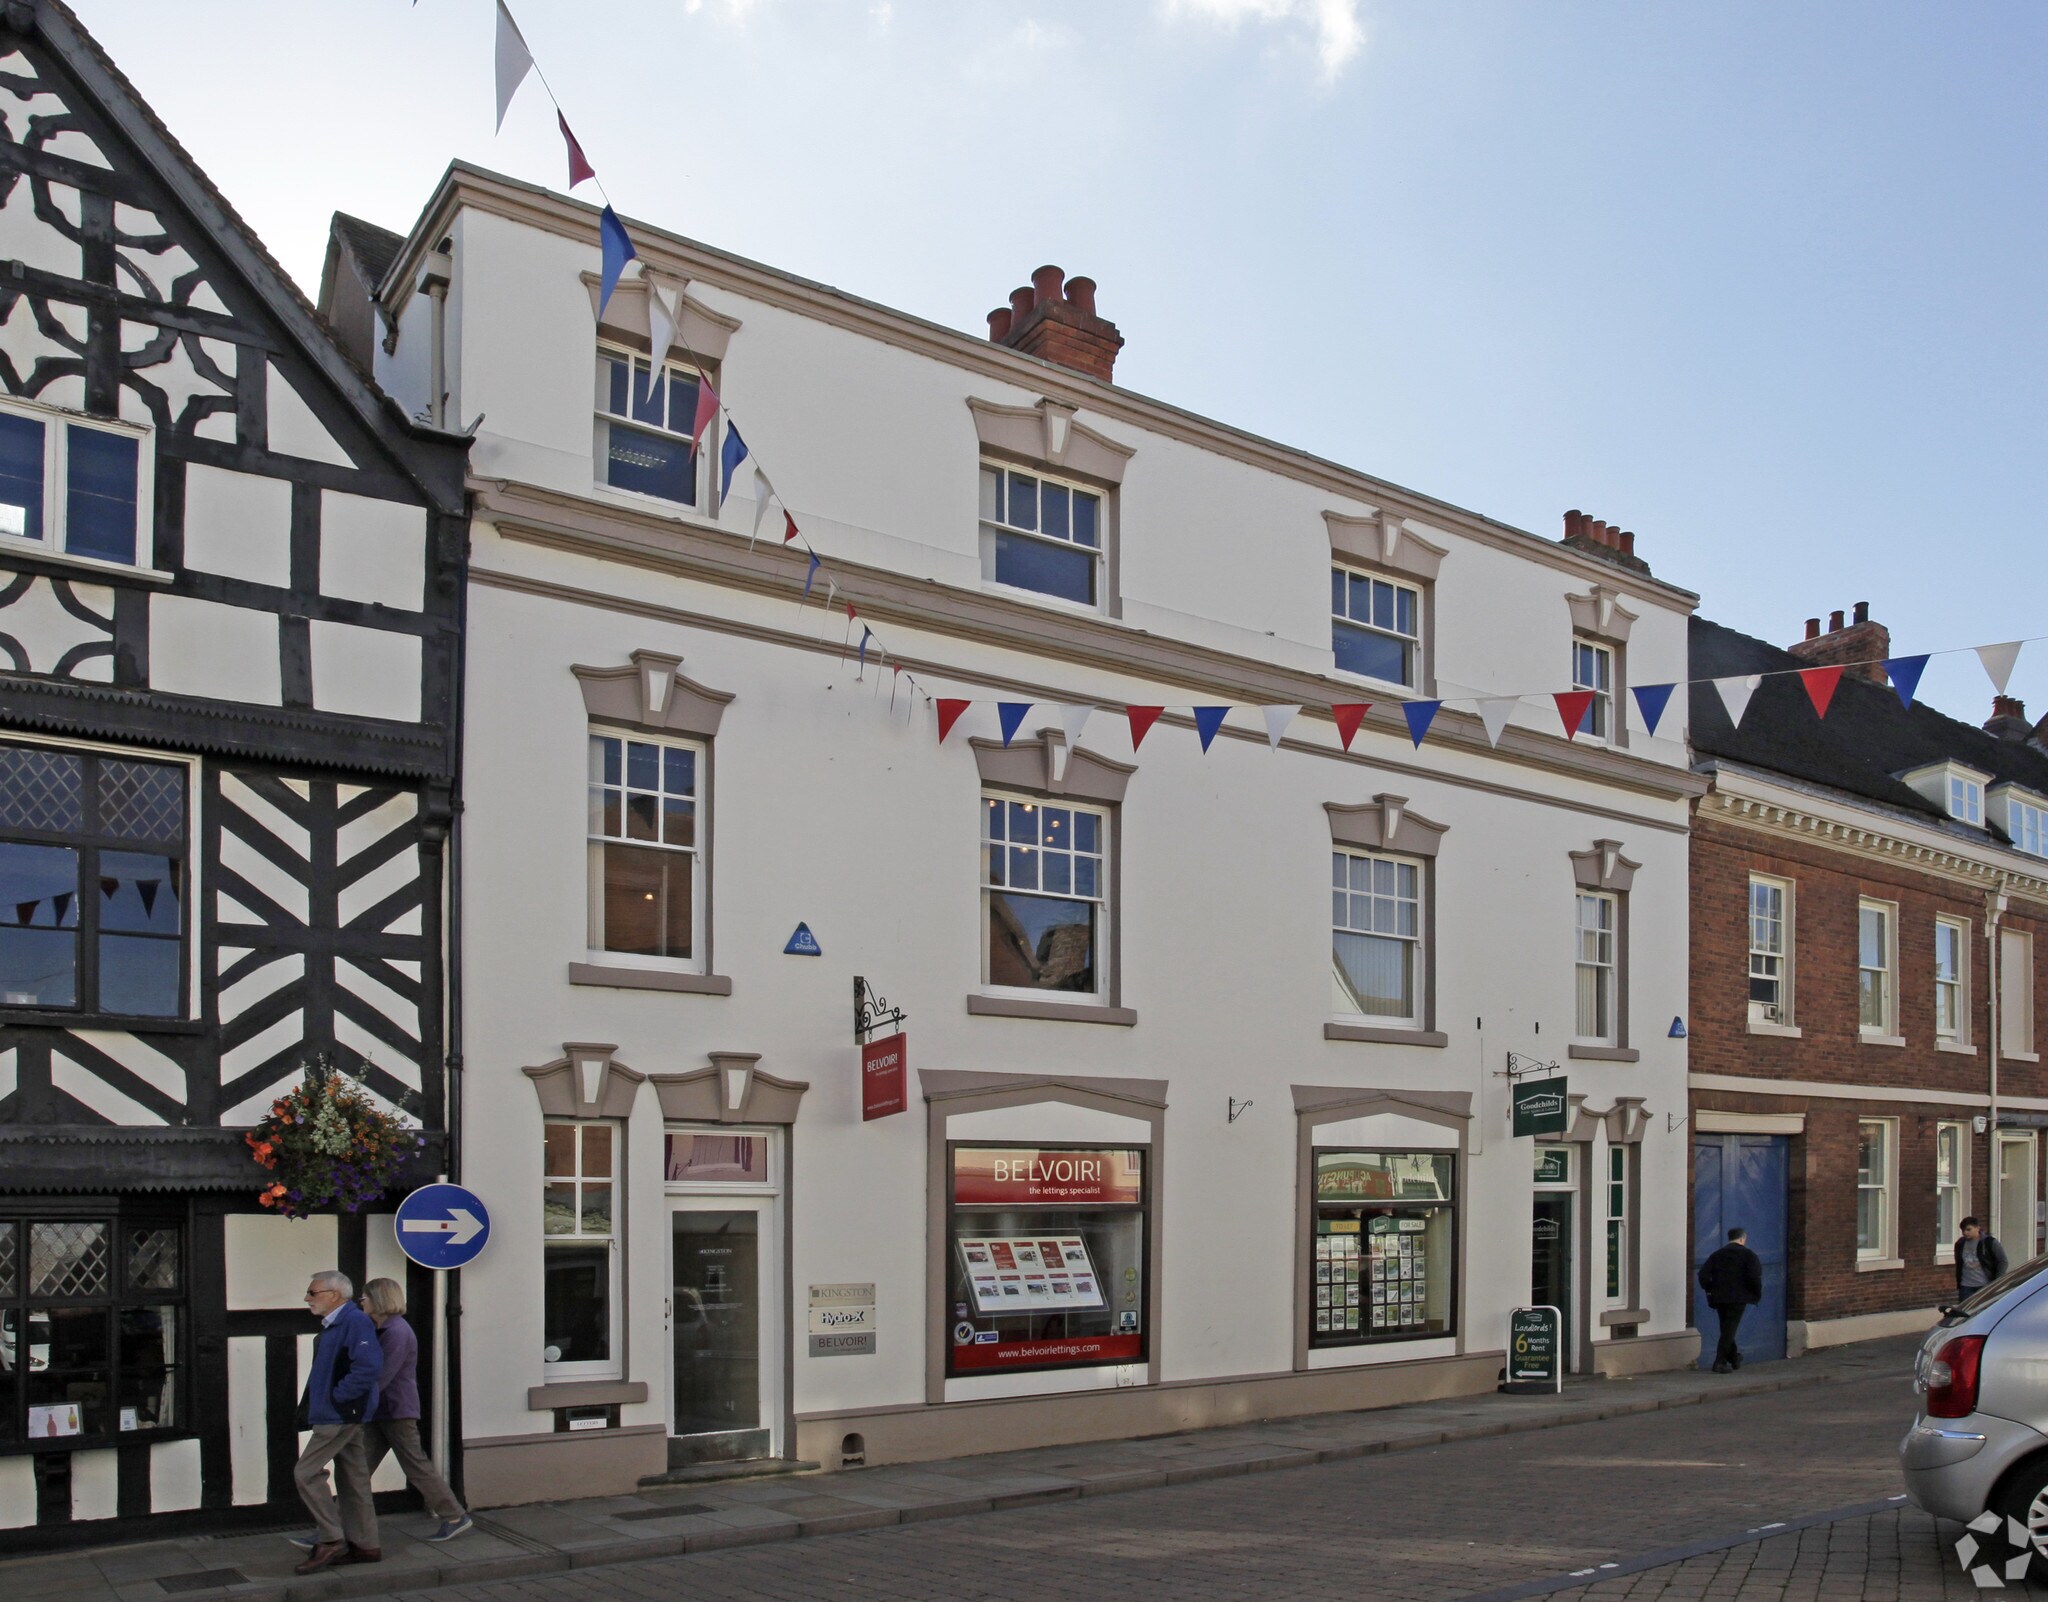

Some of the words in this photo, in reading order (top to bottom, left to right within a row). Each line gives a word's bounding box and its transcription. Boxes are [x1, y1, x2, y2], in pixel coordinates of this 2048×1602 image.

[867, 1053, 898, 1073] BELVOIR!
[1520, 1100, 1558, 1111] Goodchilds
[994, 1160, 1101, 1182] BELVOIR!
[1029, 1187, 1041, 1195] the
[1043, 1187, 1068, 1196] lettings
[1069, 1186, 1101, 1196] specialist
[821, 1287, 873, 1298] KINGSTON
[821, 1310, 865, 1326] Hydro-X
[1514, 1323, 1552, 1332] Landlords!
[818, 1336, 867, 1348] BELVOIR!
[1516, 1333, 1528, 1353] 6
[998, 1344, 1101, 1359] www.belvoirlettings.com
[1514, 1354, 1550, 1362] Guarantee
[1524, 1361, 1540, 1369] Free
